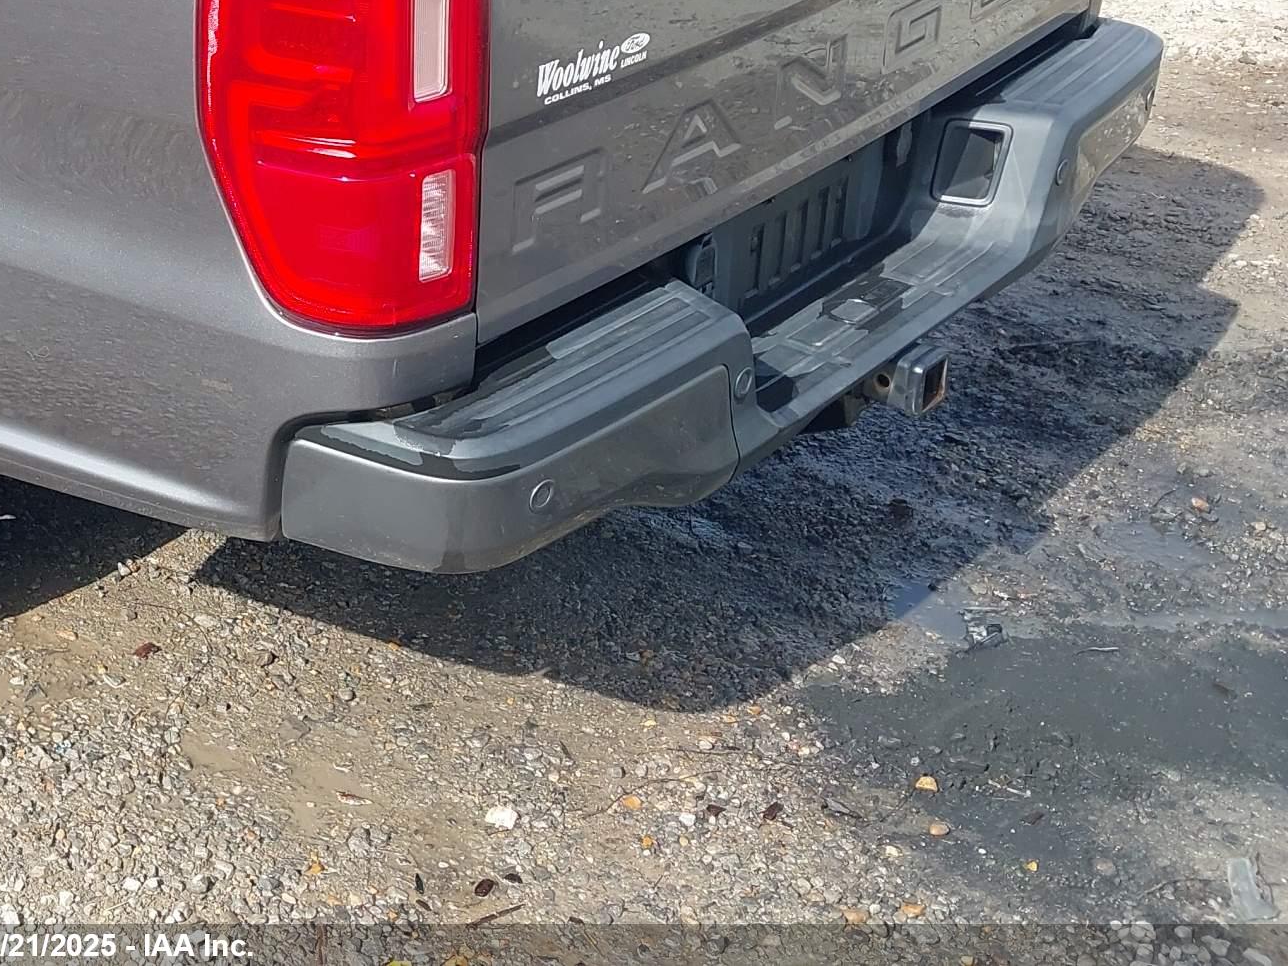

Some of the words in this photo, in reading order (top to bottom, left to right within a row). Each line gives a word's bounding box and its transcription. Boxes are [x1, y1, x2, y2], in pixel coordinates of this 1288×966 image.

[537, 40, 620, 97] Woolwine
[620, 50, 648, 68] LINCOLN
[544, 82, 592, 105] COLLINS,
[594, 74, 612, 87] MS
